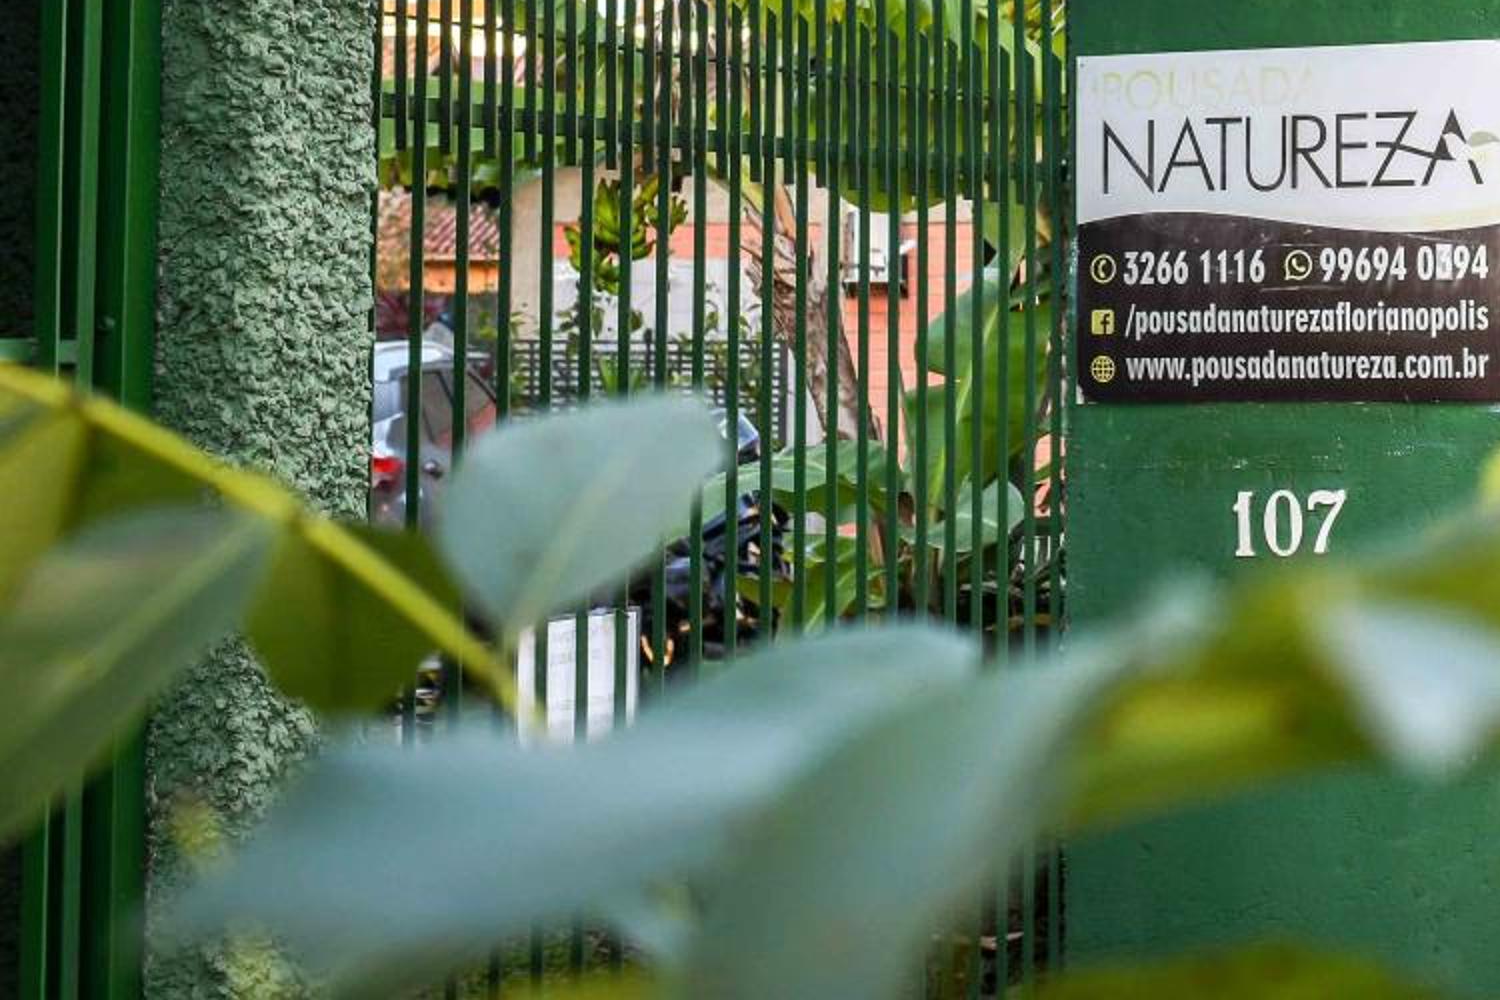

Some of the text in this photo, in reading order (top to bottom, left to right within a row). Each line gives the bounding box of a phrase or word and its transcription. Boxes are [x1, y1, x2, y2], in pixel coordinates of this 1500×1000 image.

[1103, 108, 1485, 195] NATUREZA
[1123, 250, 1190, 286] 3266
[1200, 248, 1266, 285] 1116
[1319, 246, 1408, 283] 99694
[1124, 299, 1490, 342] /pousadanaturezaflorianopolis
[1125, 347, 1490, 387] www.pousadanatureza.com.br
[1232, 489, 1348, 557] 107
